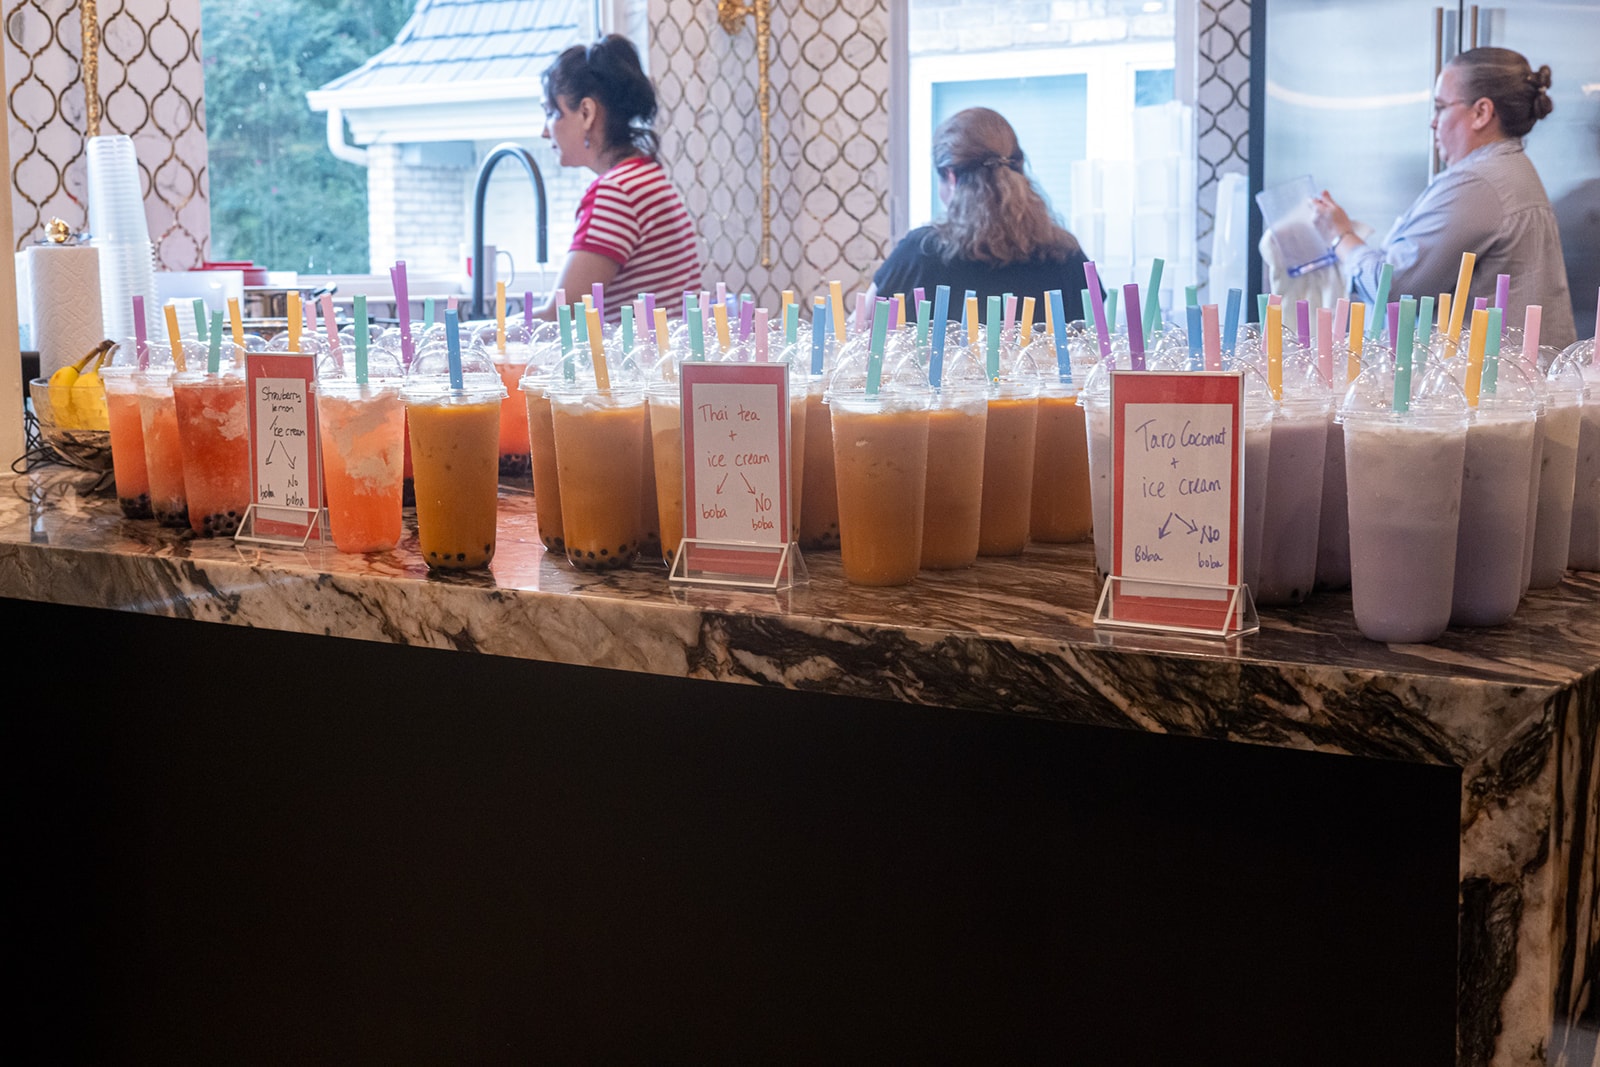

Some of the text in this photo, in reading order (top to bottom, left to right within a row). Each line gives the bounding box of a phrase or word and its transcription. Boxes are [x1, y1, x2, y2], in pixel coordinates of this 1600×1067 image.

[698, 404, 760, 422] Thai tea
[1135, 419, 1227, 451] Taro Coconut
[707, 450, 770, 468] ice cream
[1142, 476, 1222, 498] ice cream
[701, 503, 728, 519] boba
[752, 515, 774, 531] boba
[1134, 545, 1163, 562] Boba
[1198, 552, 1224, 569] boba
